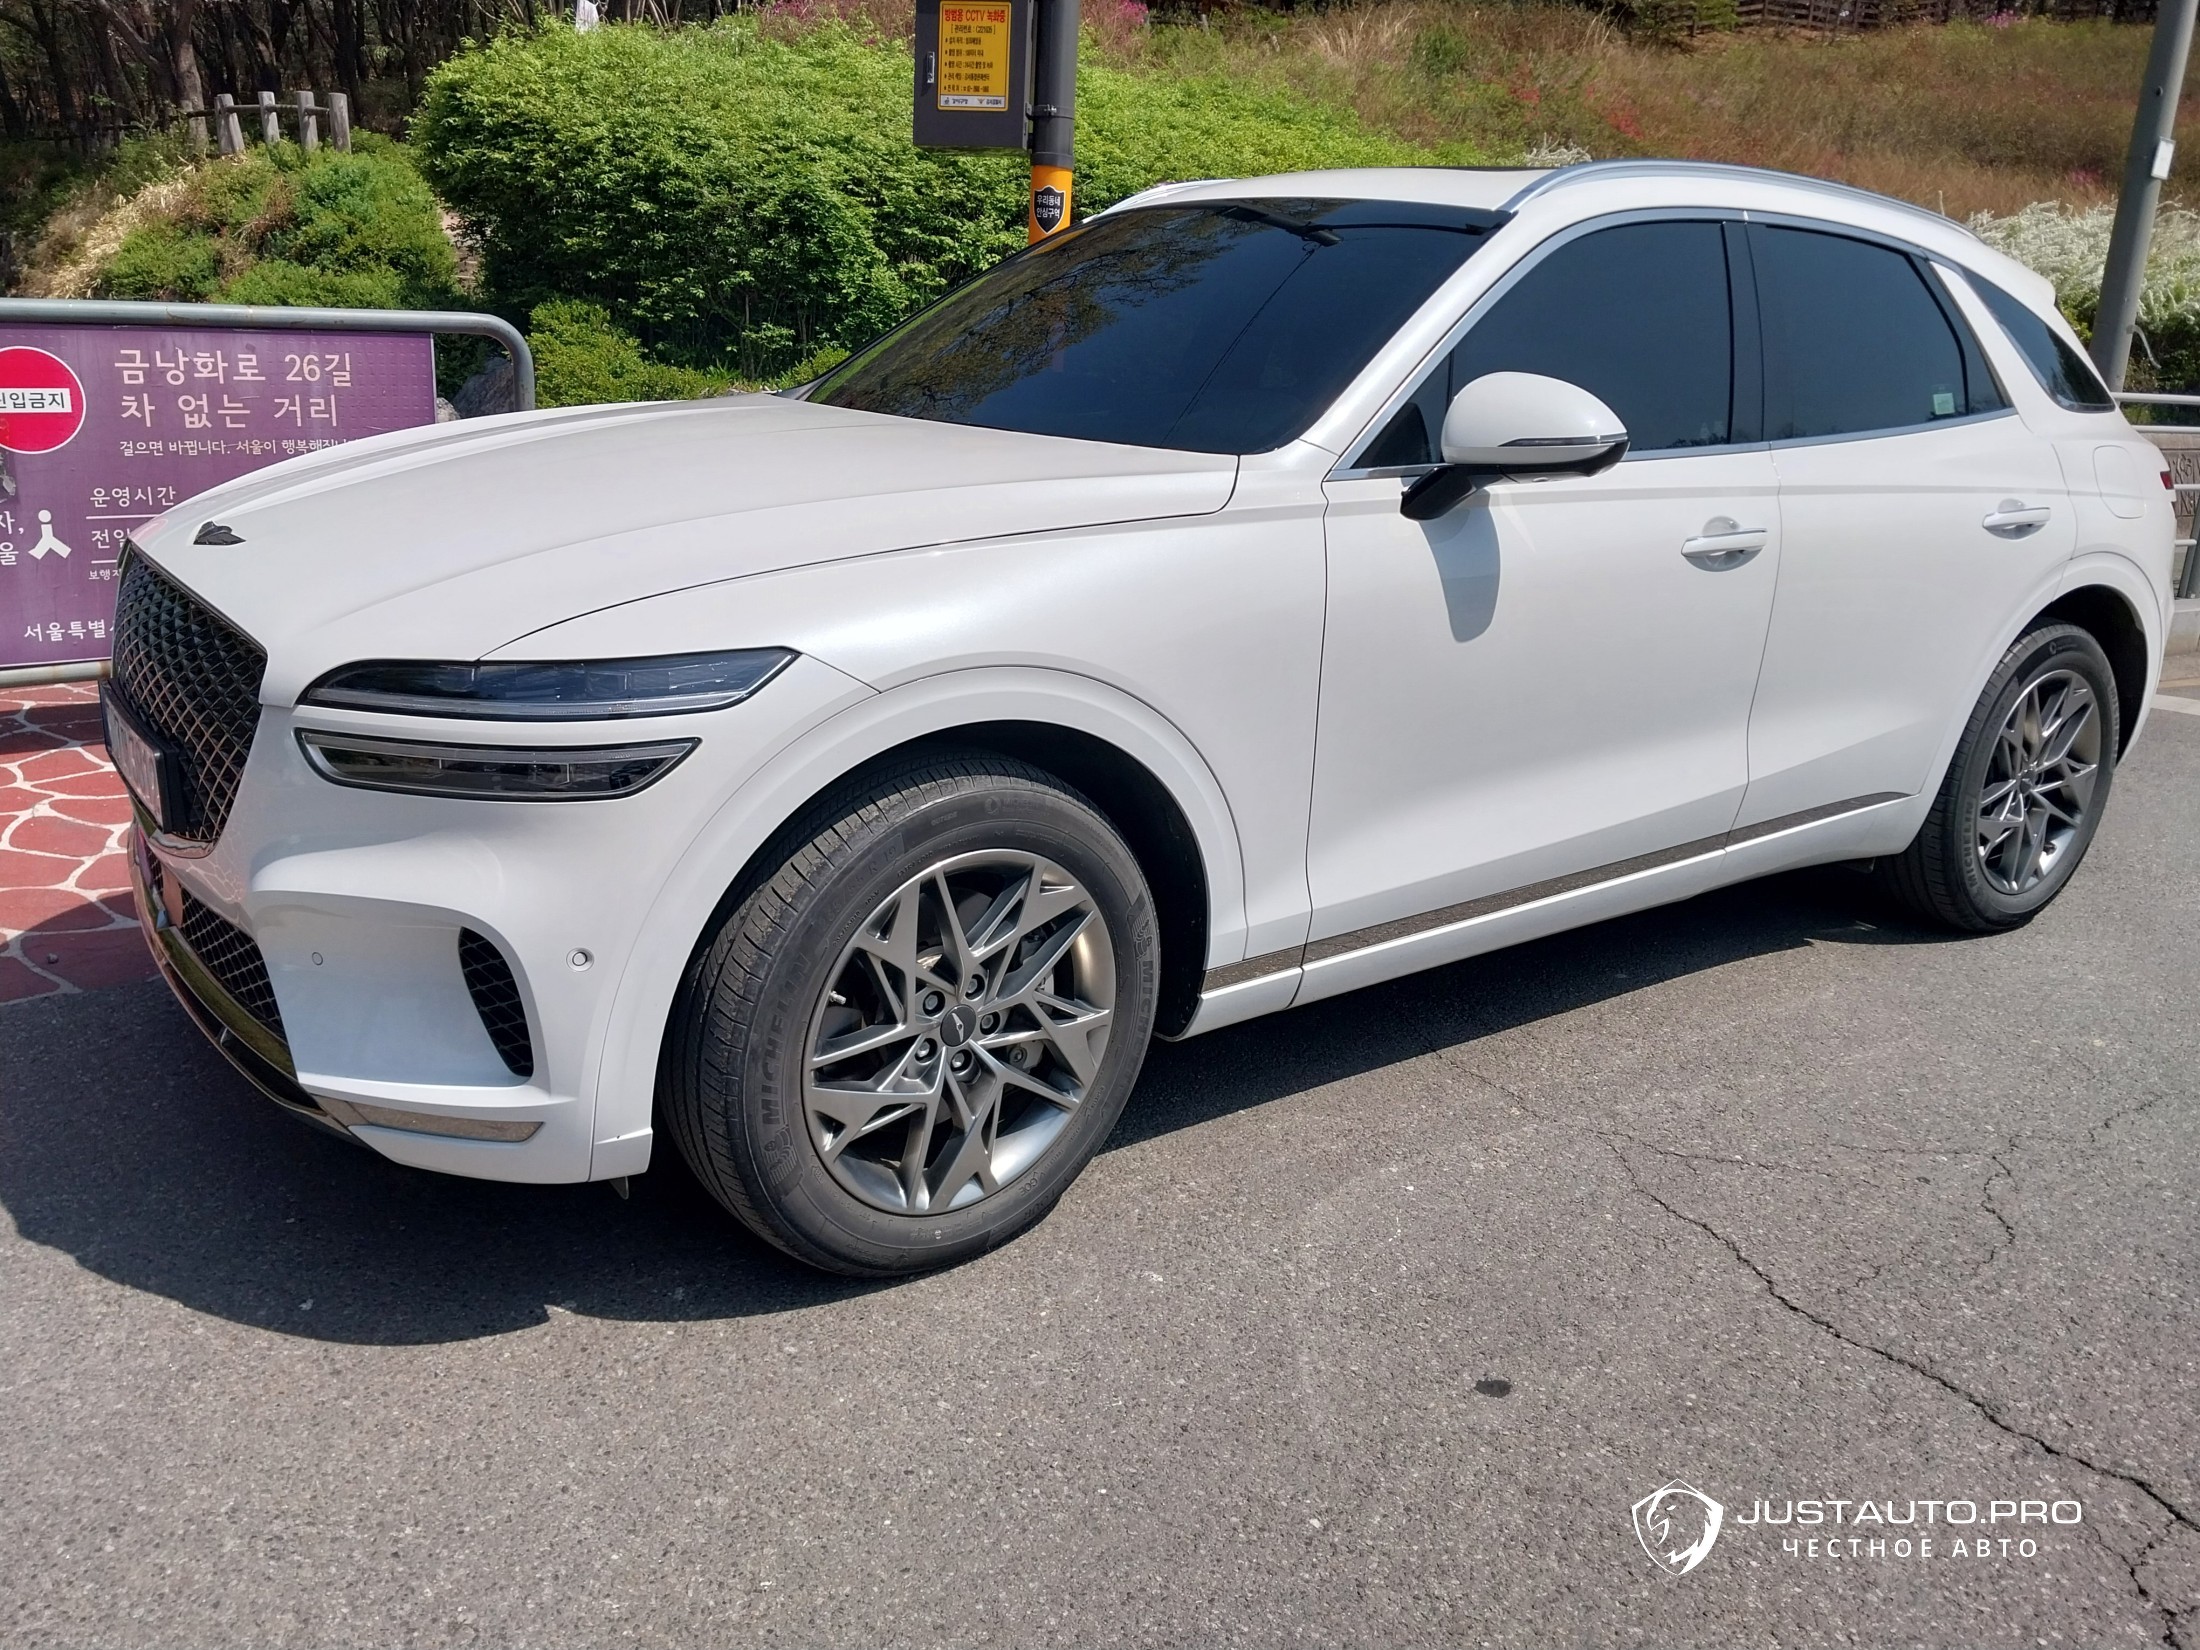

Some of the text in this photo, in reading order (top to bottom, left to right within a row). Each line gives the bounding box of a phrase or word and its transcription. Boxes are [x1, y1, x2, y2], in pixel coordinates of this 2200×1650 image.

[966, 9, 985, 22] CCTV
[1036, 194, 1061, 206] 우리동네
[114, 349, 352, 387] 금낭화로 26길
[120, 393, 337, 428] 차 없는 거리
[119, 440, 164, 457] 걸으면
[168, 439, 231, 456] 바뀝니다.
[236, 439, 276, 455] 서울이
[89, 486, 177, 508] 운영시간
[0, 541, 19, 566] 울
[24, 618, 115, 643] 서울특별
[1963, 800, 1979, 889] MICHELIN
[761, 950, 811, 1127] MICHELIN
